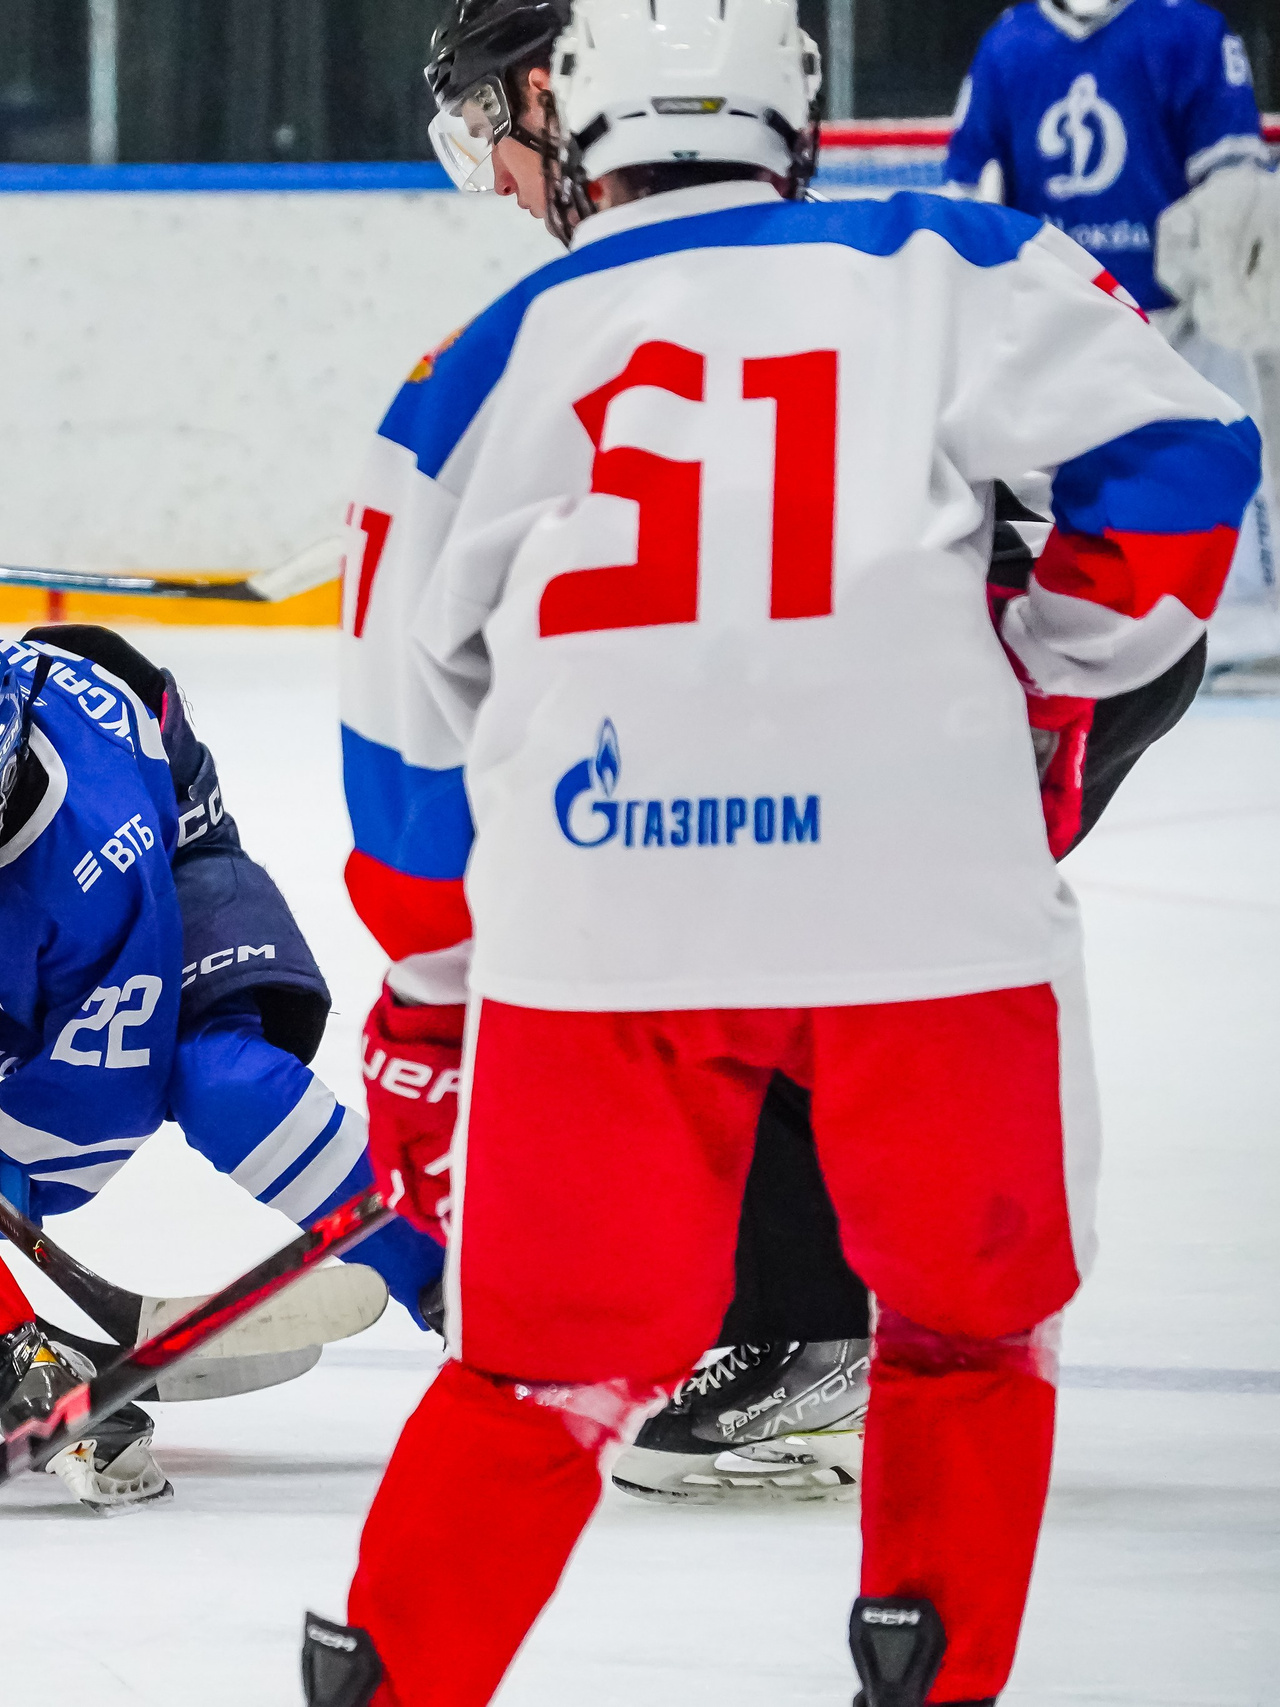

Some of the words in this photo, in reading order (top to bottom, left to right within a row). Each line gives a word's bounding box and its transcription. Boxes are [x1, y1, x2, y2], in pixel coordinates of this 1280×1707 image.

[100, 813, 156, 874] ВТБ
[624, 795, 822, 848] ГАЗПРОМ
[50, 974, 163, 1069] 22
